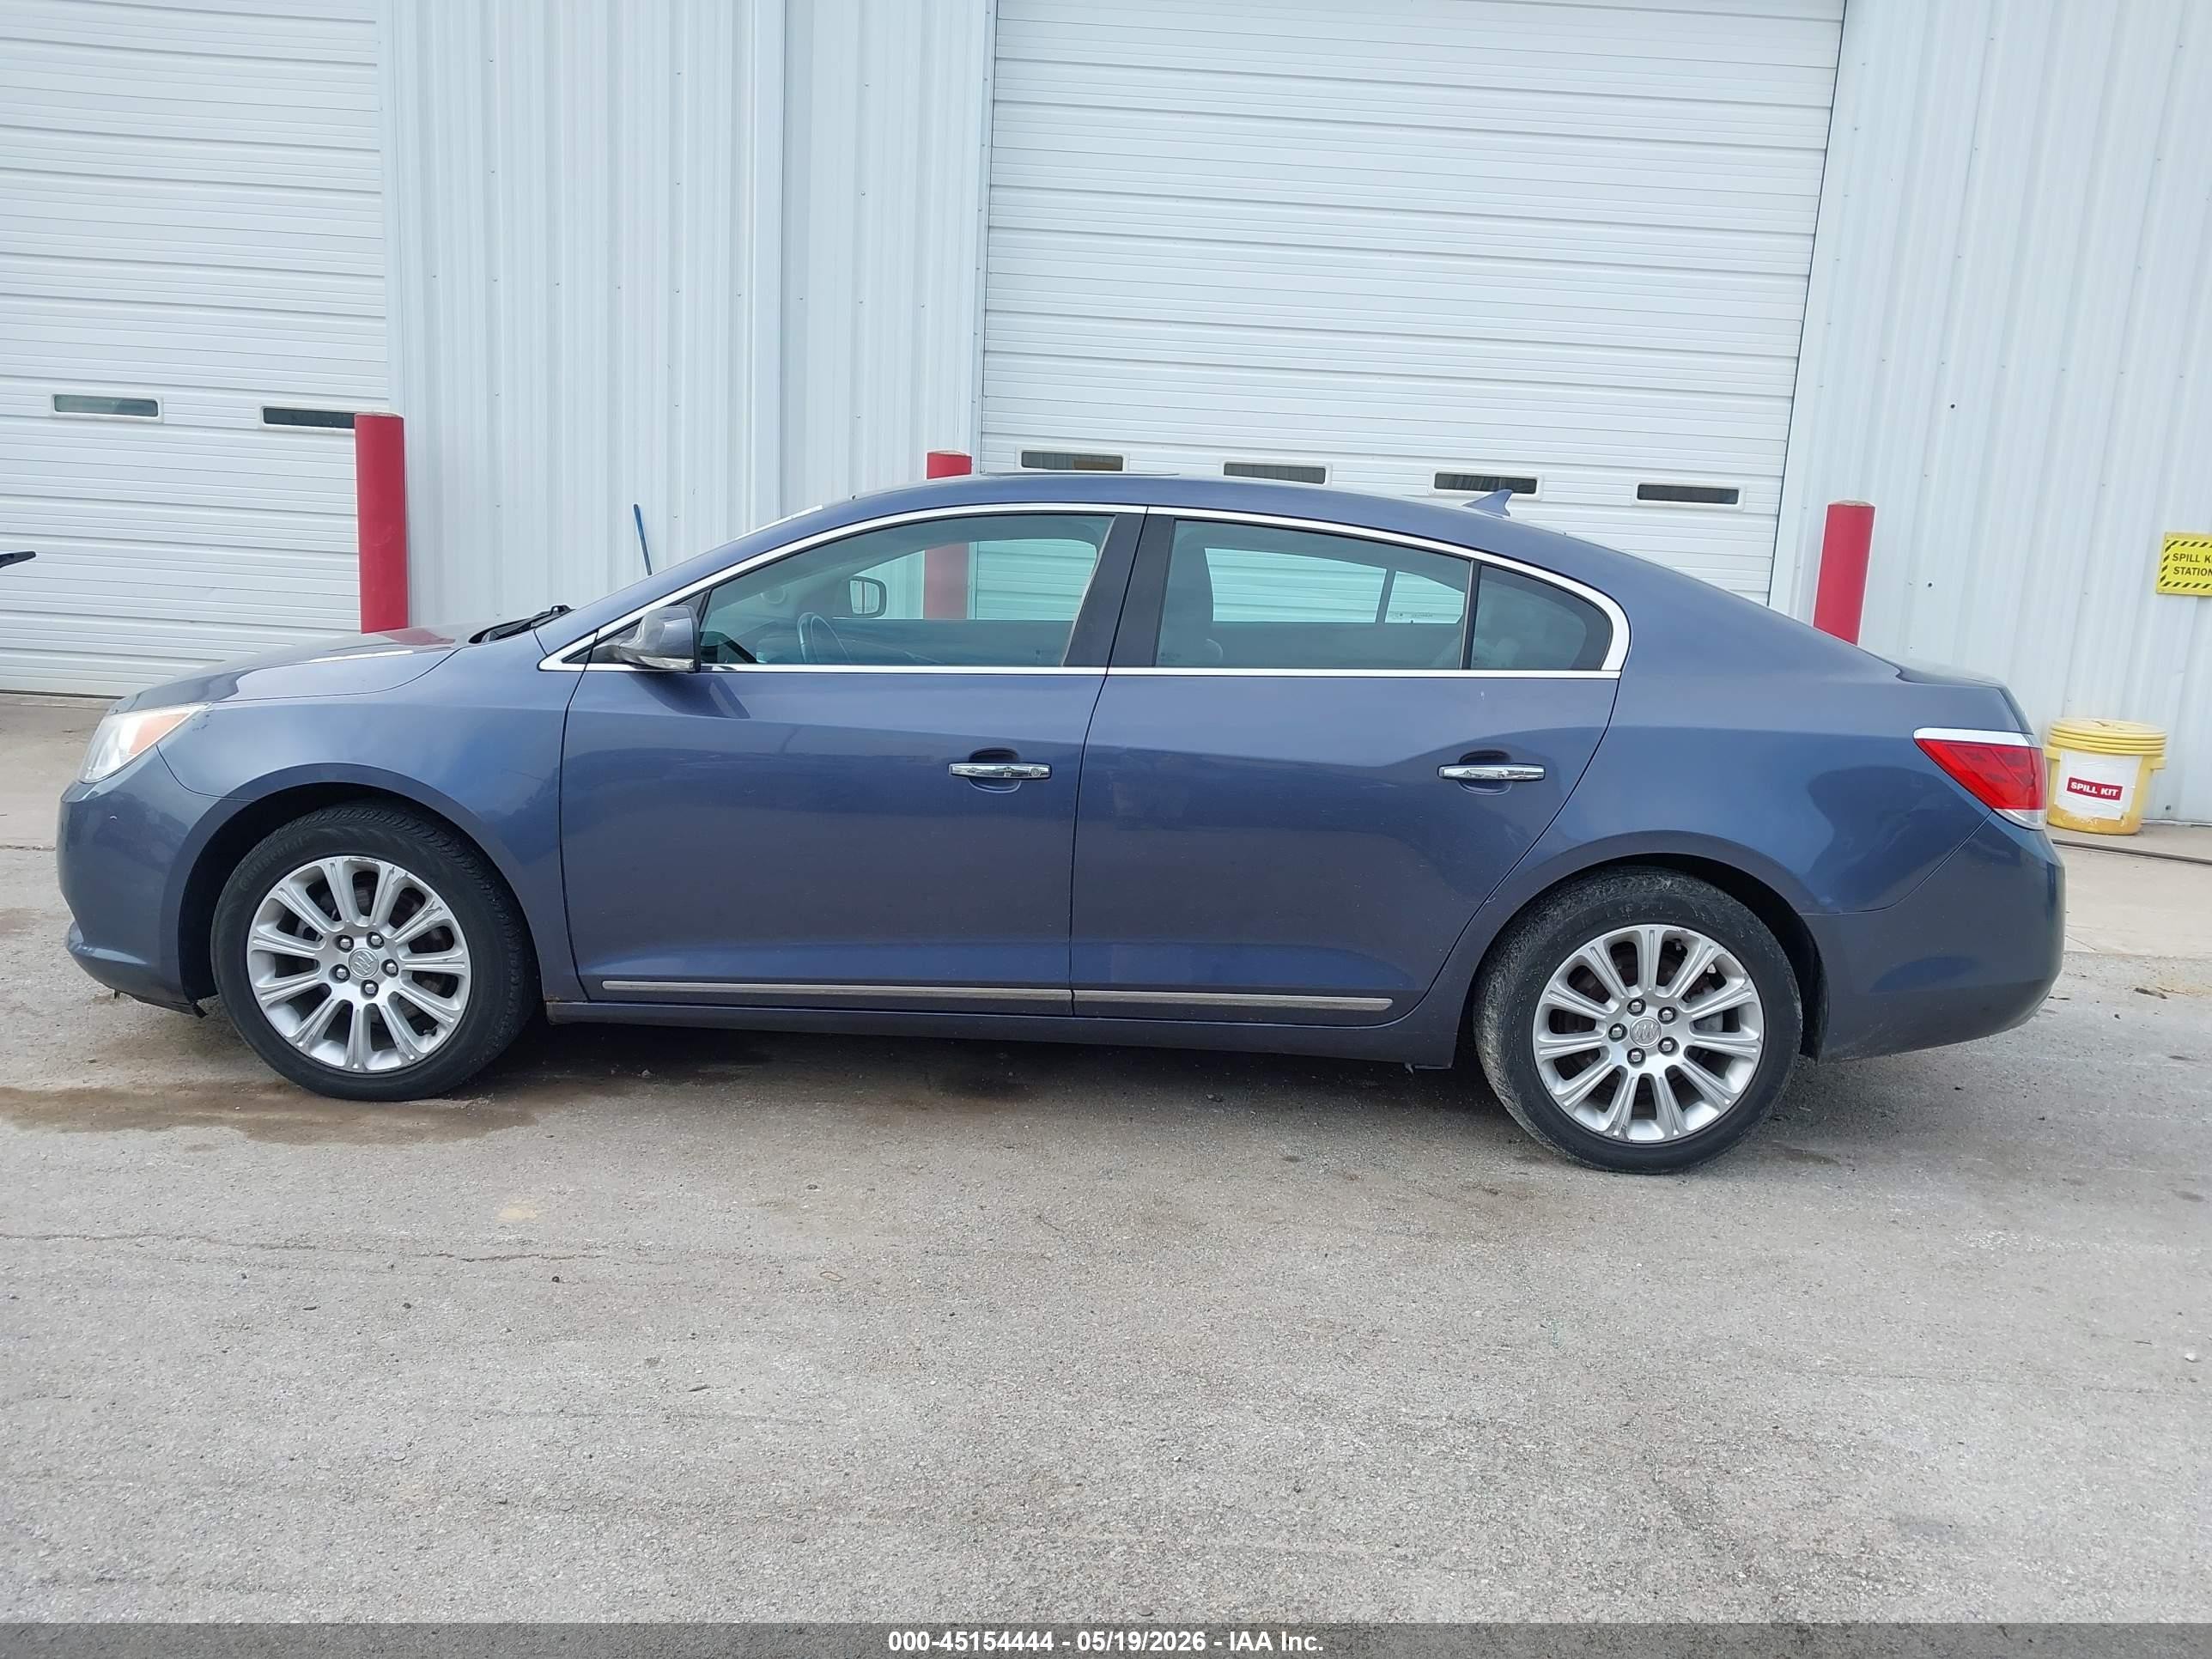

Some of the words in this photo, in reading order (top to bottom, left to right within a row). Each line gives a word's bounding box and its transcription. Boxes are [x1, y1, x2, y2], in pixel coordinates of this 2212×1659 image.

[2172, 553, 2201, 563] SPILL
[2070, 781, 2098, 794] SPILL
[2100, 788, 2119, 797] KIT
